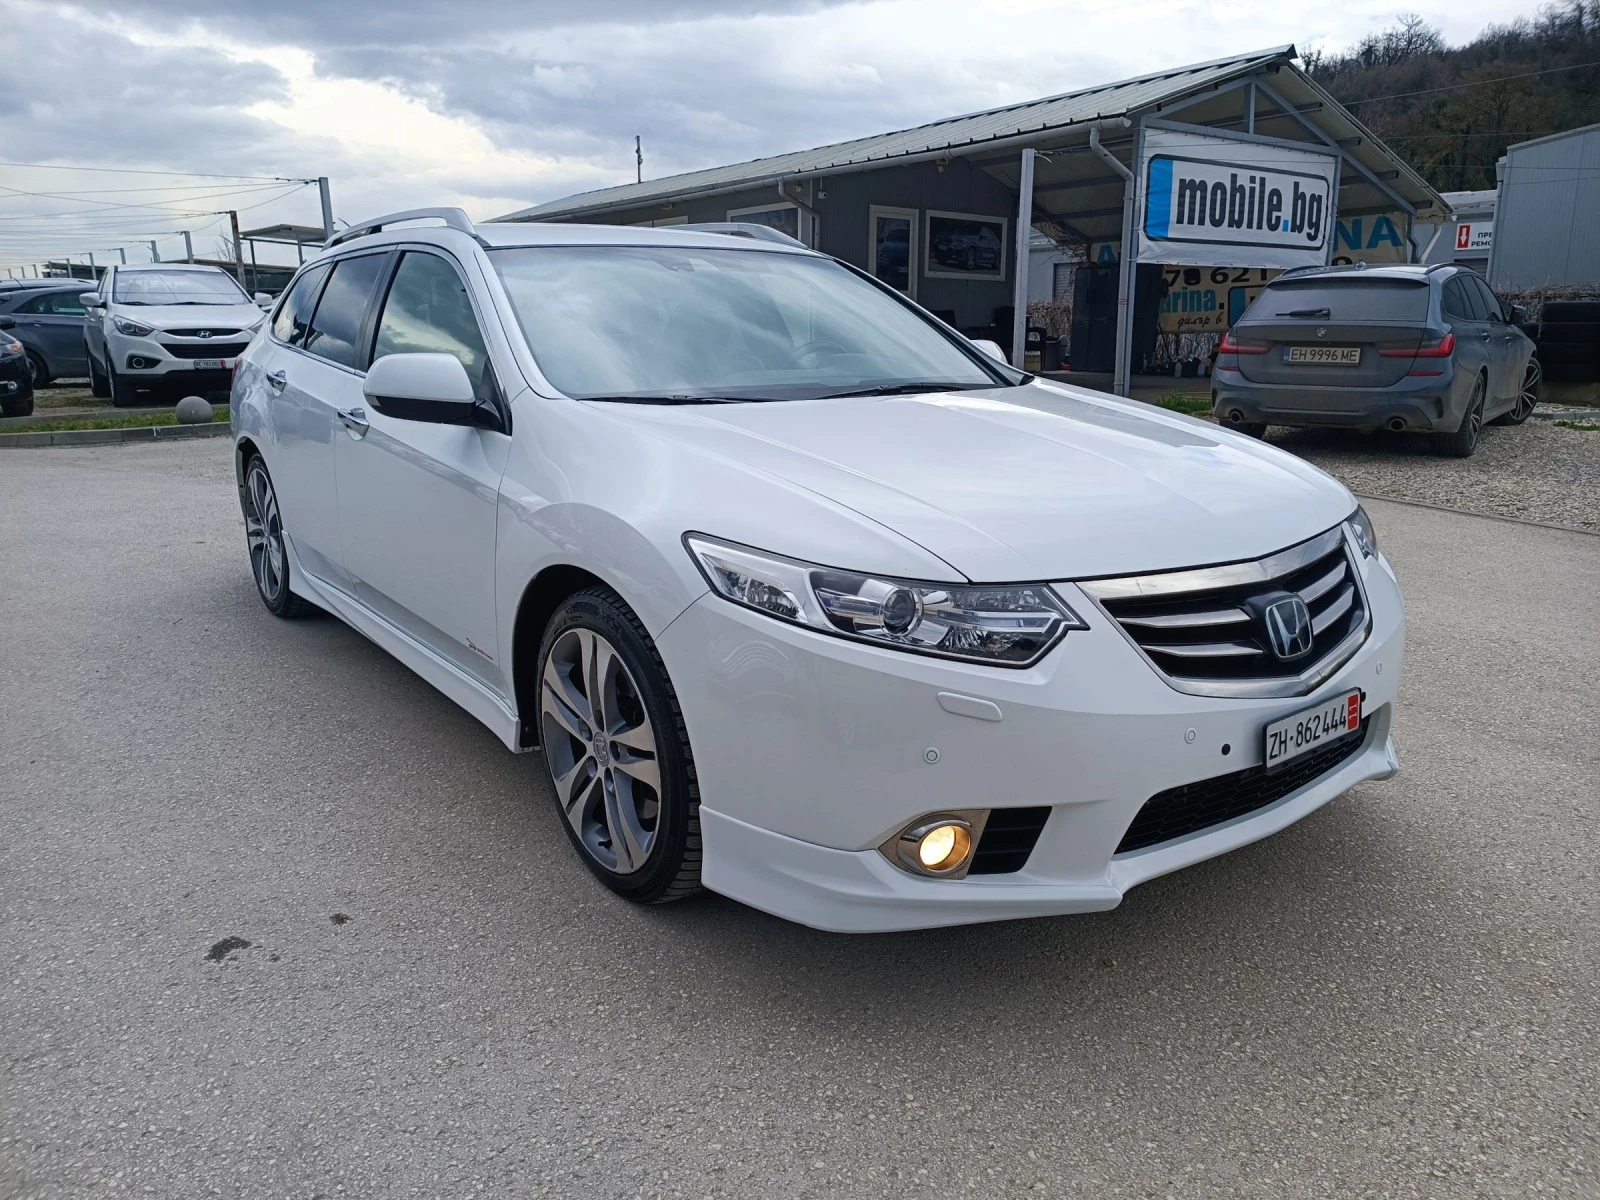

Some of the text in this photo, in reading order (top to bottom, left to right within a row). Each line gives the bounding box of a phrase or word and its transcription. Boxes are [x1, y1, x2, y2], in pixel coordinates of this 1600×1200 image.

[1175, 173, 1323, 242] mobile.bg
[1290, 348, 1308, 361] EH
[1309, 348, 1339, 362] 9996
[1340, 349, 1359, 362] ME
